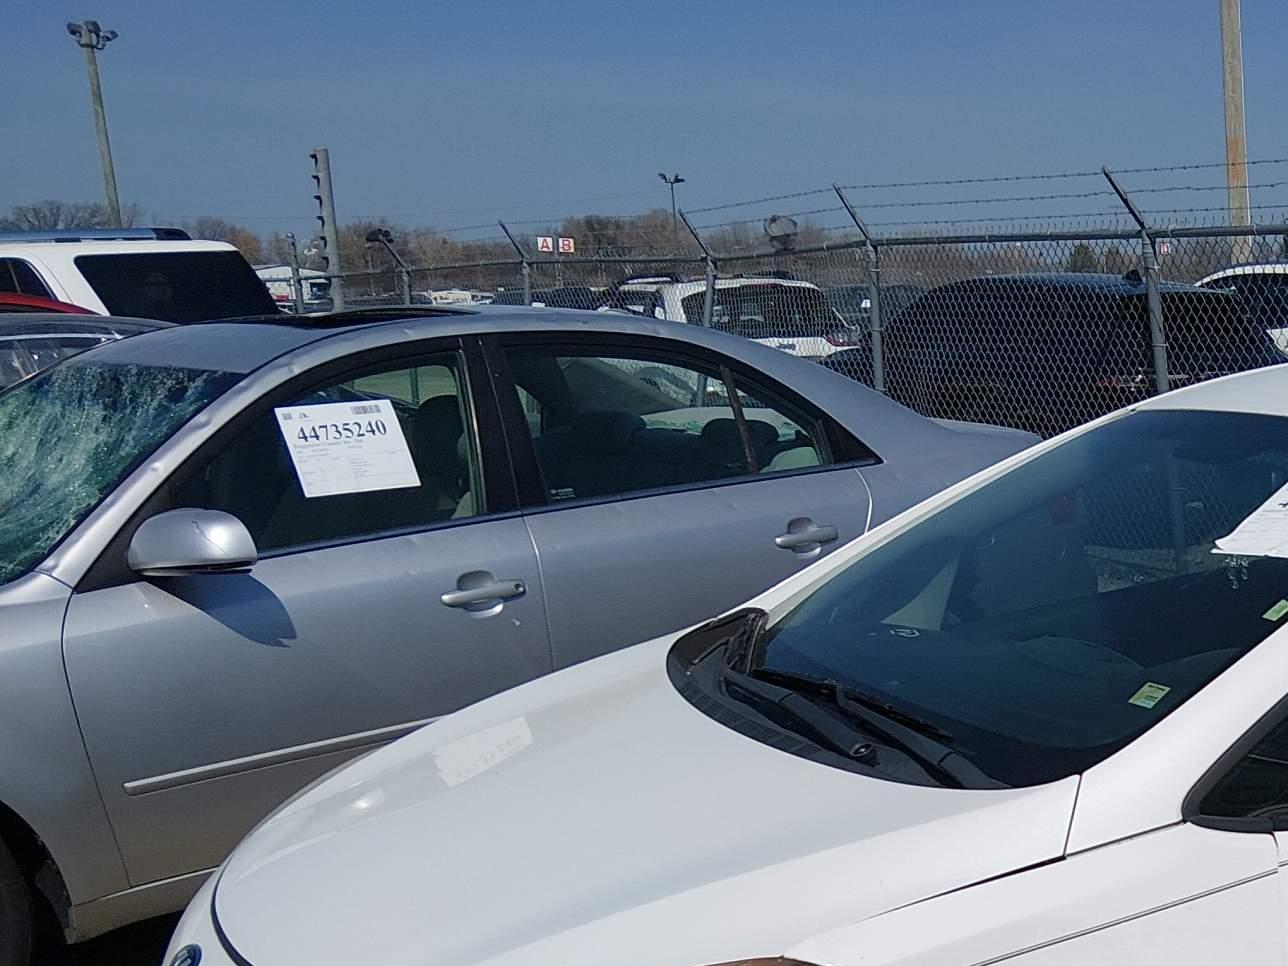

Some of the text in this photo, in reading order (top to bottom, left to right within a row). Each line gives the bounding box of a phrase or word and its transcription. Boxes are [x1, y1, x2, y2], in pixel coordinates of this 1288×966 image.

[541, 238, 551, 250] A
[562, 239, 572, 251] B
[297, 419, 387, 443] 44735240
